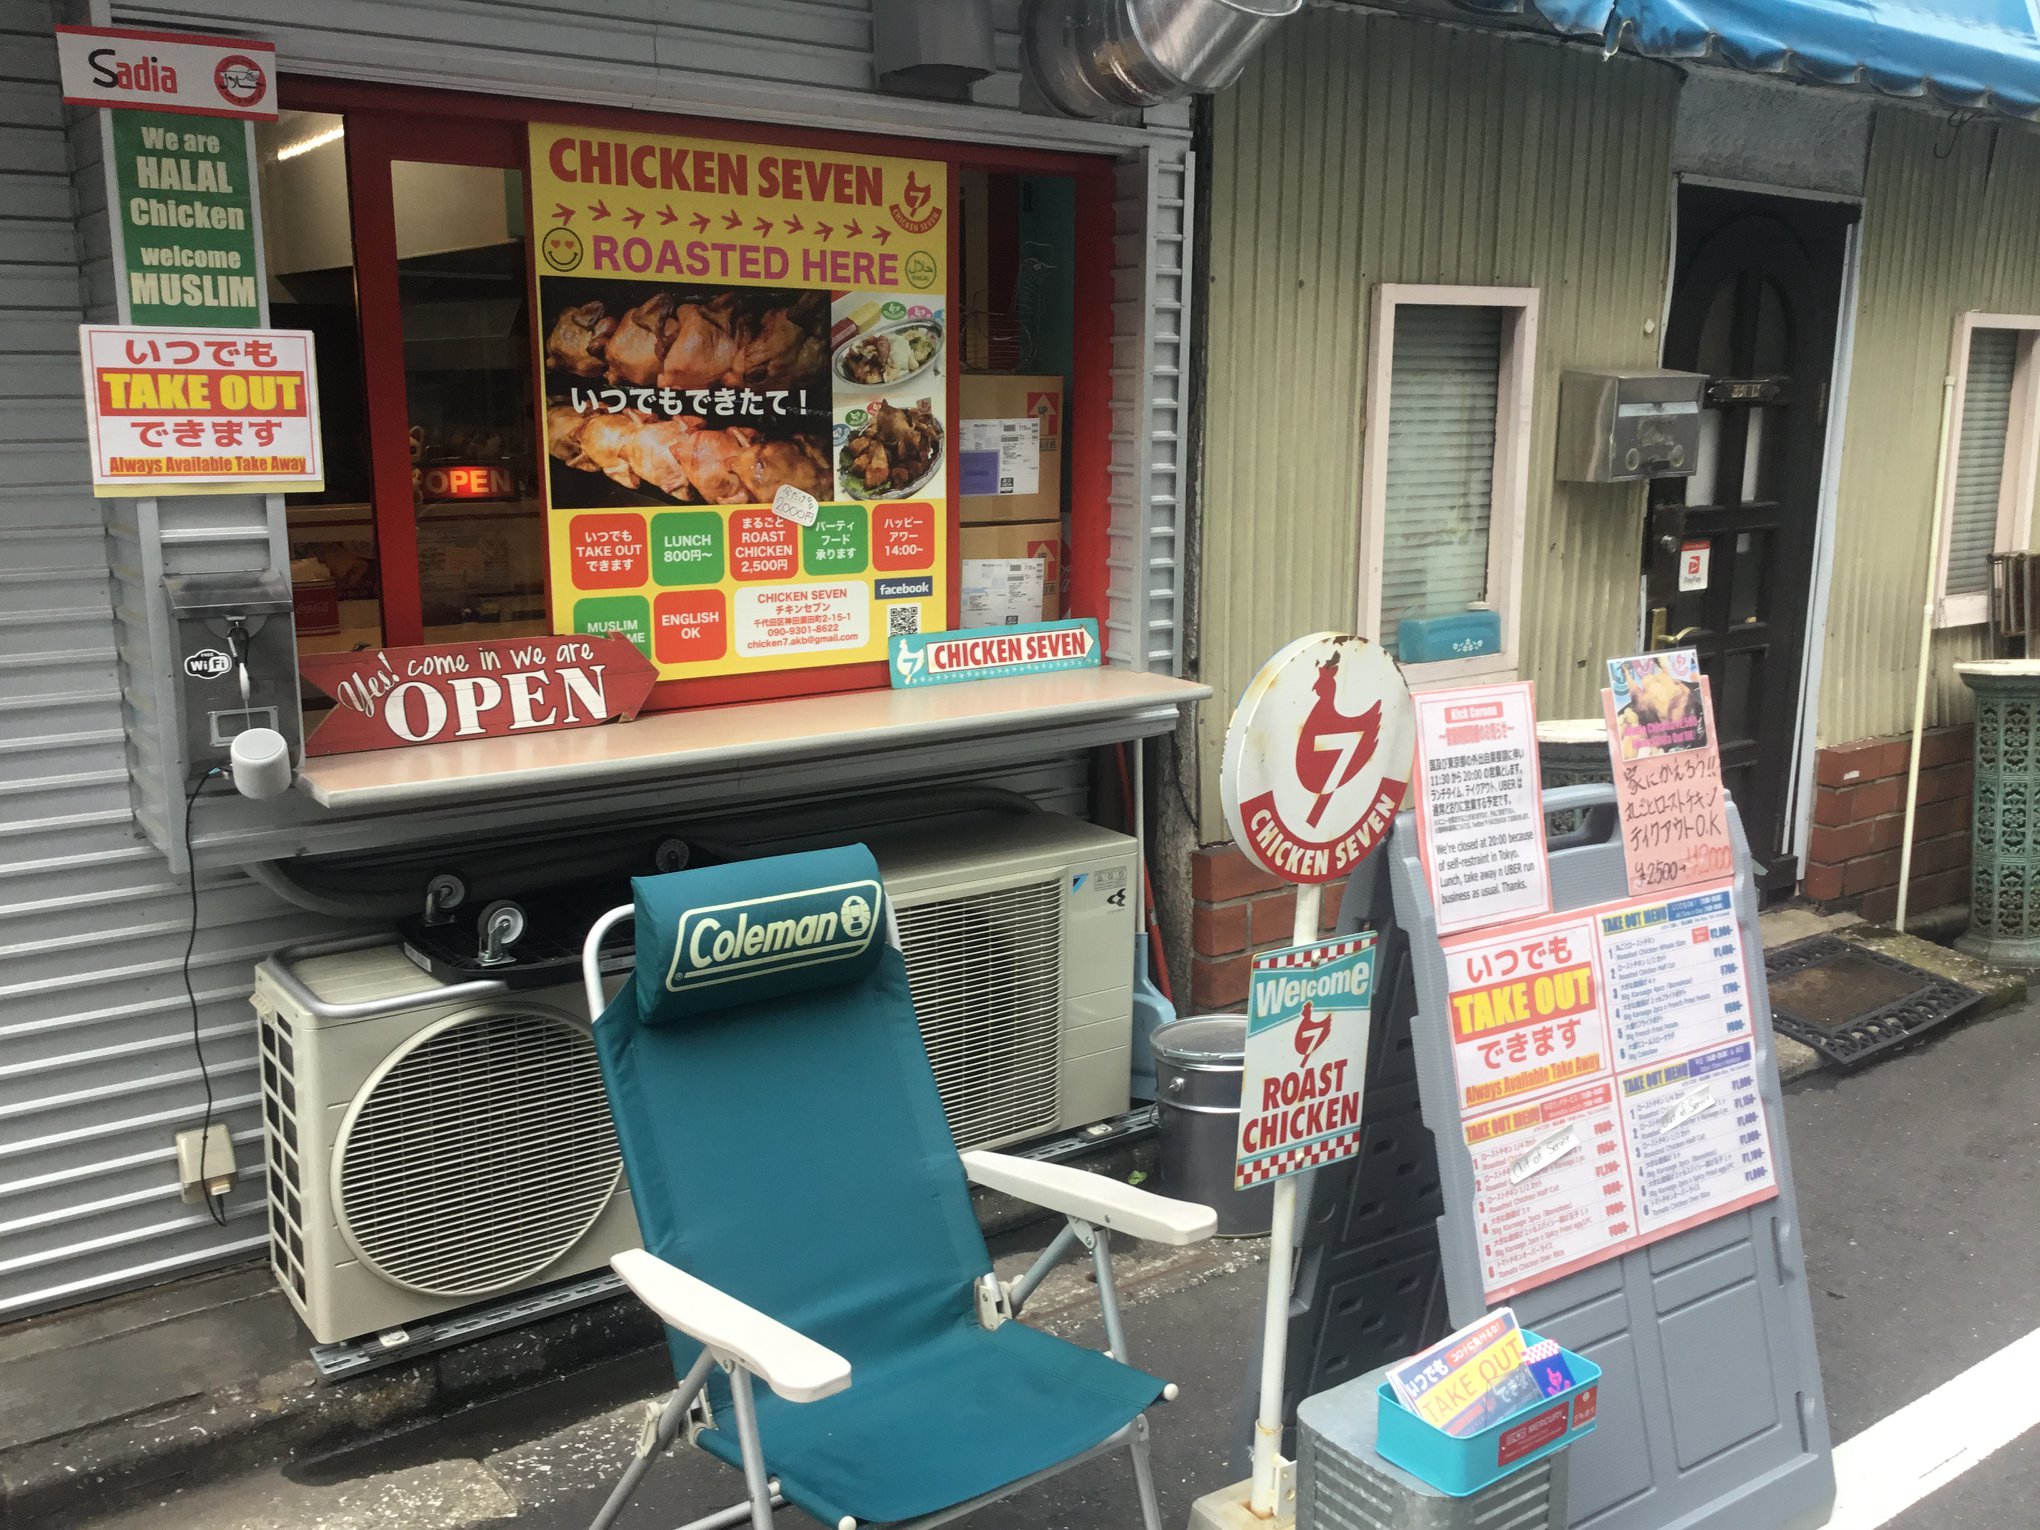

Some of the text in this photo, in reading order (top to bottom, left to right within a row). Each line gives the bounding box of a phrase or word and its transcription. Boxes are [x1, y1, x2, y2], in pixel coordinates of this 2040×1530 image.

[88, 49, 178, 94] Sadia
[141, 126, 220, 153] We are
[137, 156, 233, 193] HALAL
[549, 137, 884, 207] CHICKEN SEVEN
[130, 197, 245, 231] Chicken
[892, 208, 919, 232] CHICKEN
[141, 245, 241, 269] welcome
[592, 235, 899, 286] ROASTED HERE
[131, 273, 257, 308] MUSLIM
[125, 338, 278, 368] いつでも
[103, 373, 302, 411] TAKE OUT
[571, 386, 808, 416] いつでもできたて！
[131, 420, 282, 449] できます
[110, 455, 306, 475] Always Available Take Away
[425, 469, 512, 494] OPEN
[742, 517, 785, 529] まるごと
[884, 517, 924, 529] ハッピー
[585, 530, 632, 542] いつでも
[664, 535, 711, 547] LUNCH
[741, 531, 785, 543] ROAST
[821, 534, 851, 546] フード
[889, 531, 918, 543] アワー
[576, 544, 642, 557] TAKE OUT
[735, 545, 793, 558] CHICKEN
[815, 548, 856, 560] 承ります
[586, 558, 634, 572] できます
[741, 560, 788, 573] 2,500円
[758, 588, 847, 604] CHICKEN SEVEN
[880, 582, 929, 595] facebook
[661, 612, 719, 626] ENGLISH
[775, 603, 831, 615] チキンセブン
[587, 620, 638, 633] MUSLIM
[681, 627, 701, 639] OK
[767, 624, 839, 637] 090-9301-8622
[747, 633, 858, 649] chicken7.akb@gmail.com
[934, 632, 1086, 670] CHICKEN SEVEN
[337, 651, 401, 718] Yes!
[407, 654, 470, 678] come
[479, 647, 502, 671] in
[556, 642, 594, 664] are
[384, 665, 608, 743] OPEN
[1306, 731, 1365, 829] 7
[1431, 773, 1450, 786] 11:30
[1463, 768, 1482, 782] 20:00
[1499, 779, 1516, 791] UBER
[1251, 793, 1395, 876] CHICKEN SEVEN
[1436, 831, 1533, 855] We're closed at 20:00 because
[1438, 859, 1445, 871] of
[1447, 852, 1489, 870] self-restraint
[1490, 851, 1498, 862] in
[1440, 874, 1462, 887] Lunch,
[1463, 871, 1479, 883] take
[1480, 869, 1497, 880] away
[1504, 863, 1522, 875] UBER
[1523, 862, 1535, 872] run
[1441, 891, 1471, 904] business
[1472, 889, 1480, 898] as
[1502, 880, 1527, 892] Thanks.
[1602, 916, 1623, 933] TAKE
[1624, 912, 1642, 928] OUT
[689, 911, 838, 969] Coleman
[1466, 936, 1572, 983] いつでも
[1256, 961, 1370, 1018] Welcome
[1453, 982, 1530, 1034] TAKE
[1534, 967, 1591, 1015] OUT
[1477, 1018, 1581, 1070] できます
[1261, 1058, 1348, 1112] ROAST
[1466, 1053, 1600, 1104] Always Available Take Away
[1623, 1075, 1645, 1093] TAKE
[1646, 1070, 1663, 1088] OUT
[1242, 1091, 1360, 1153] CHICKEN
[1465, 1121, 1491, 1142] TAKE
[1491, 1115, 1511, 1134] OUT
[1533, 1147, 1543, 1164] of
[1406, 1359, 1448, 1398] いつでも
[1423, 1373, 1477, 1423] TAKE
[1479, 1337, 1523, 1382] OUT
